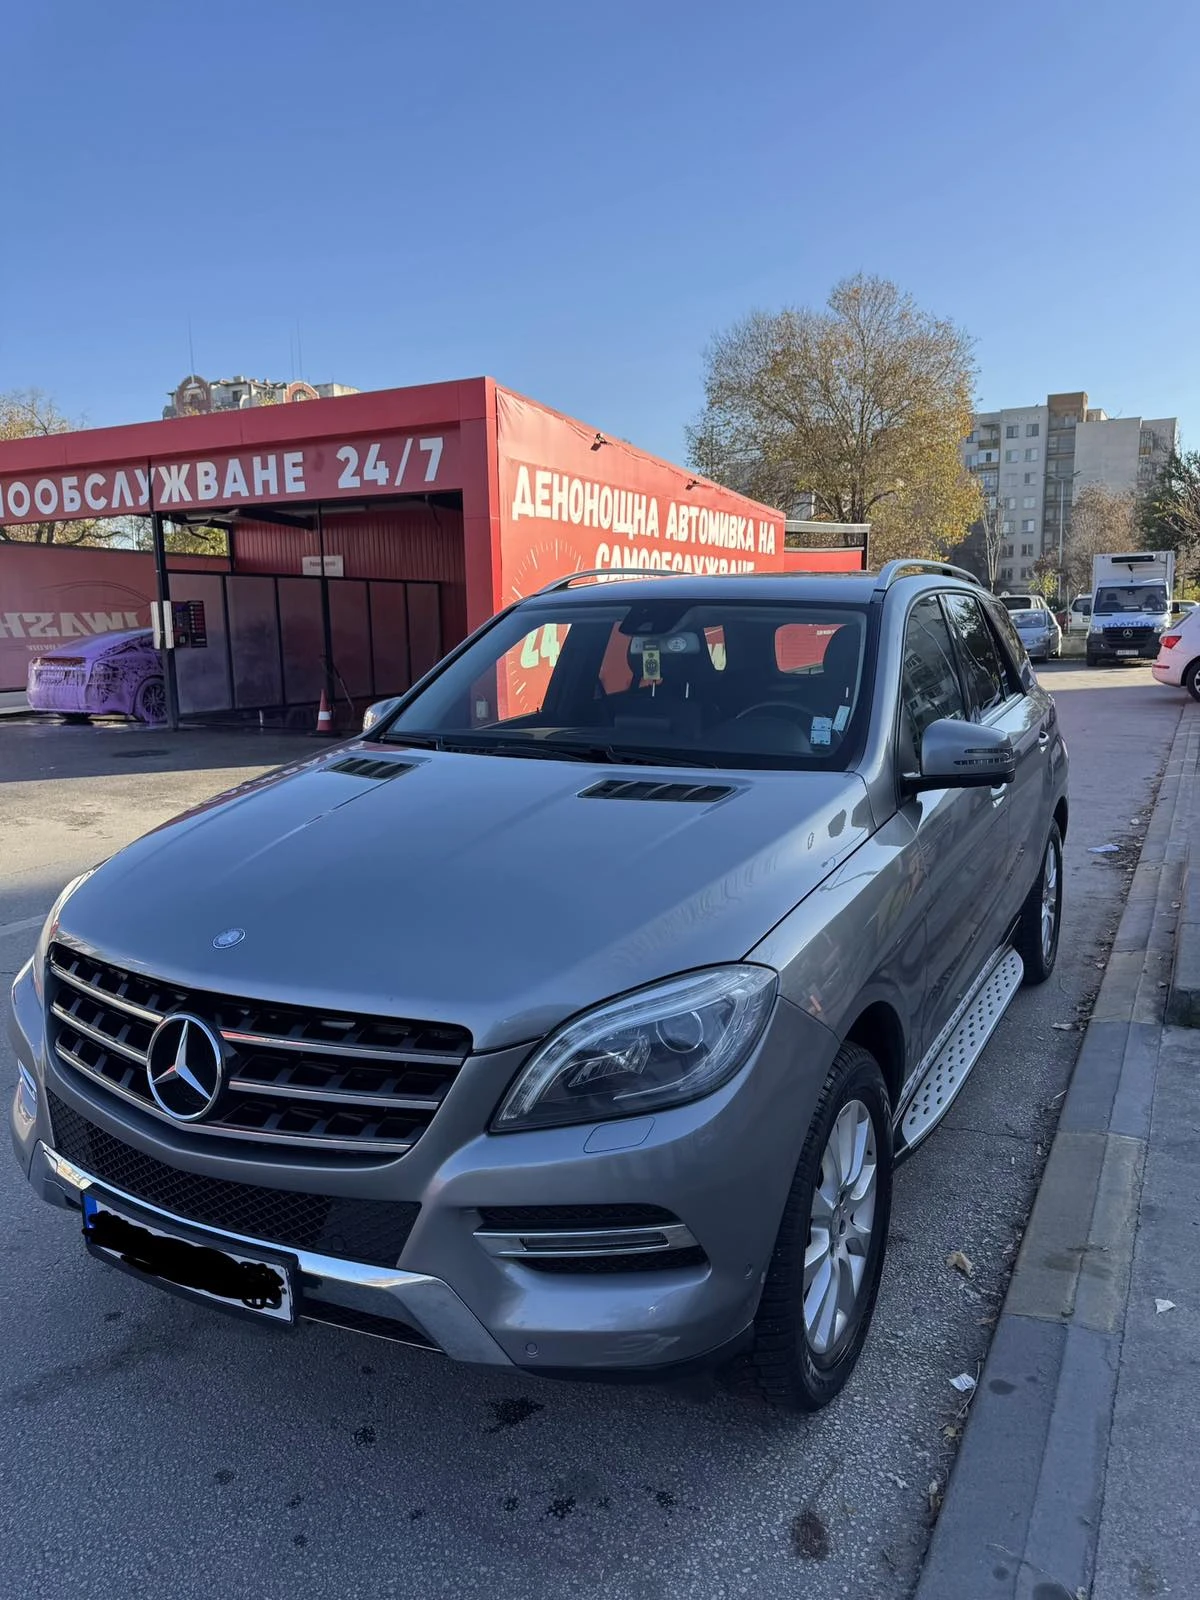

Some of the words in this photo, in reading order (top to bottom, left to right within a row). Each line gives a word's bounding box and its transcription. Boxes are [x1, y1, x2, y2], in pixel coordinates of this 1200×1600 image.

[0, 451, 306, 518] ООБСЛУЖВАНЕ
[336, 436, 443, 489] 24/7
[511, 465, 660, 540] ДЕНОНОЩНА
[665, 501, 755, 552] АВТОМИВКА
[758, 522, 776, 555] НА
